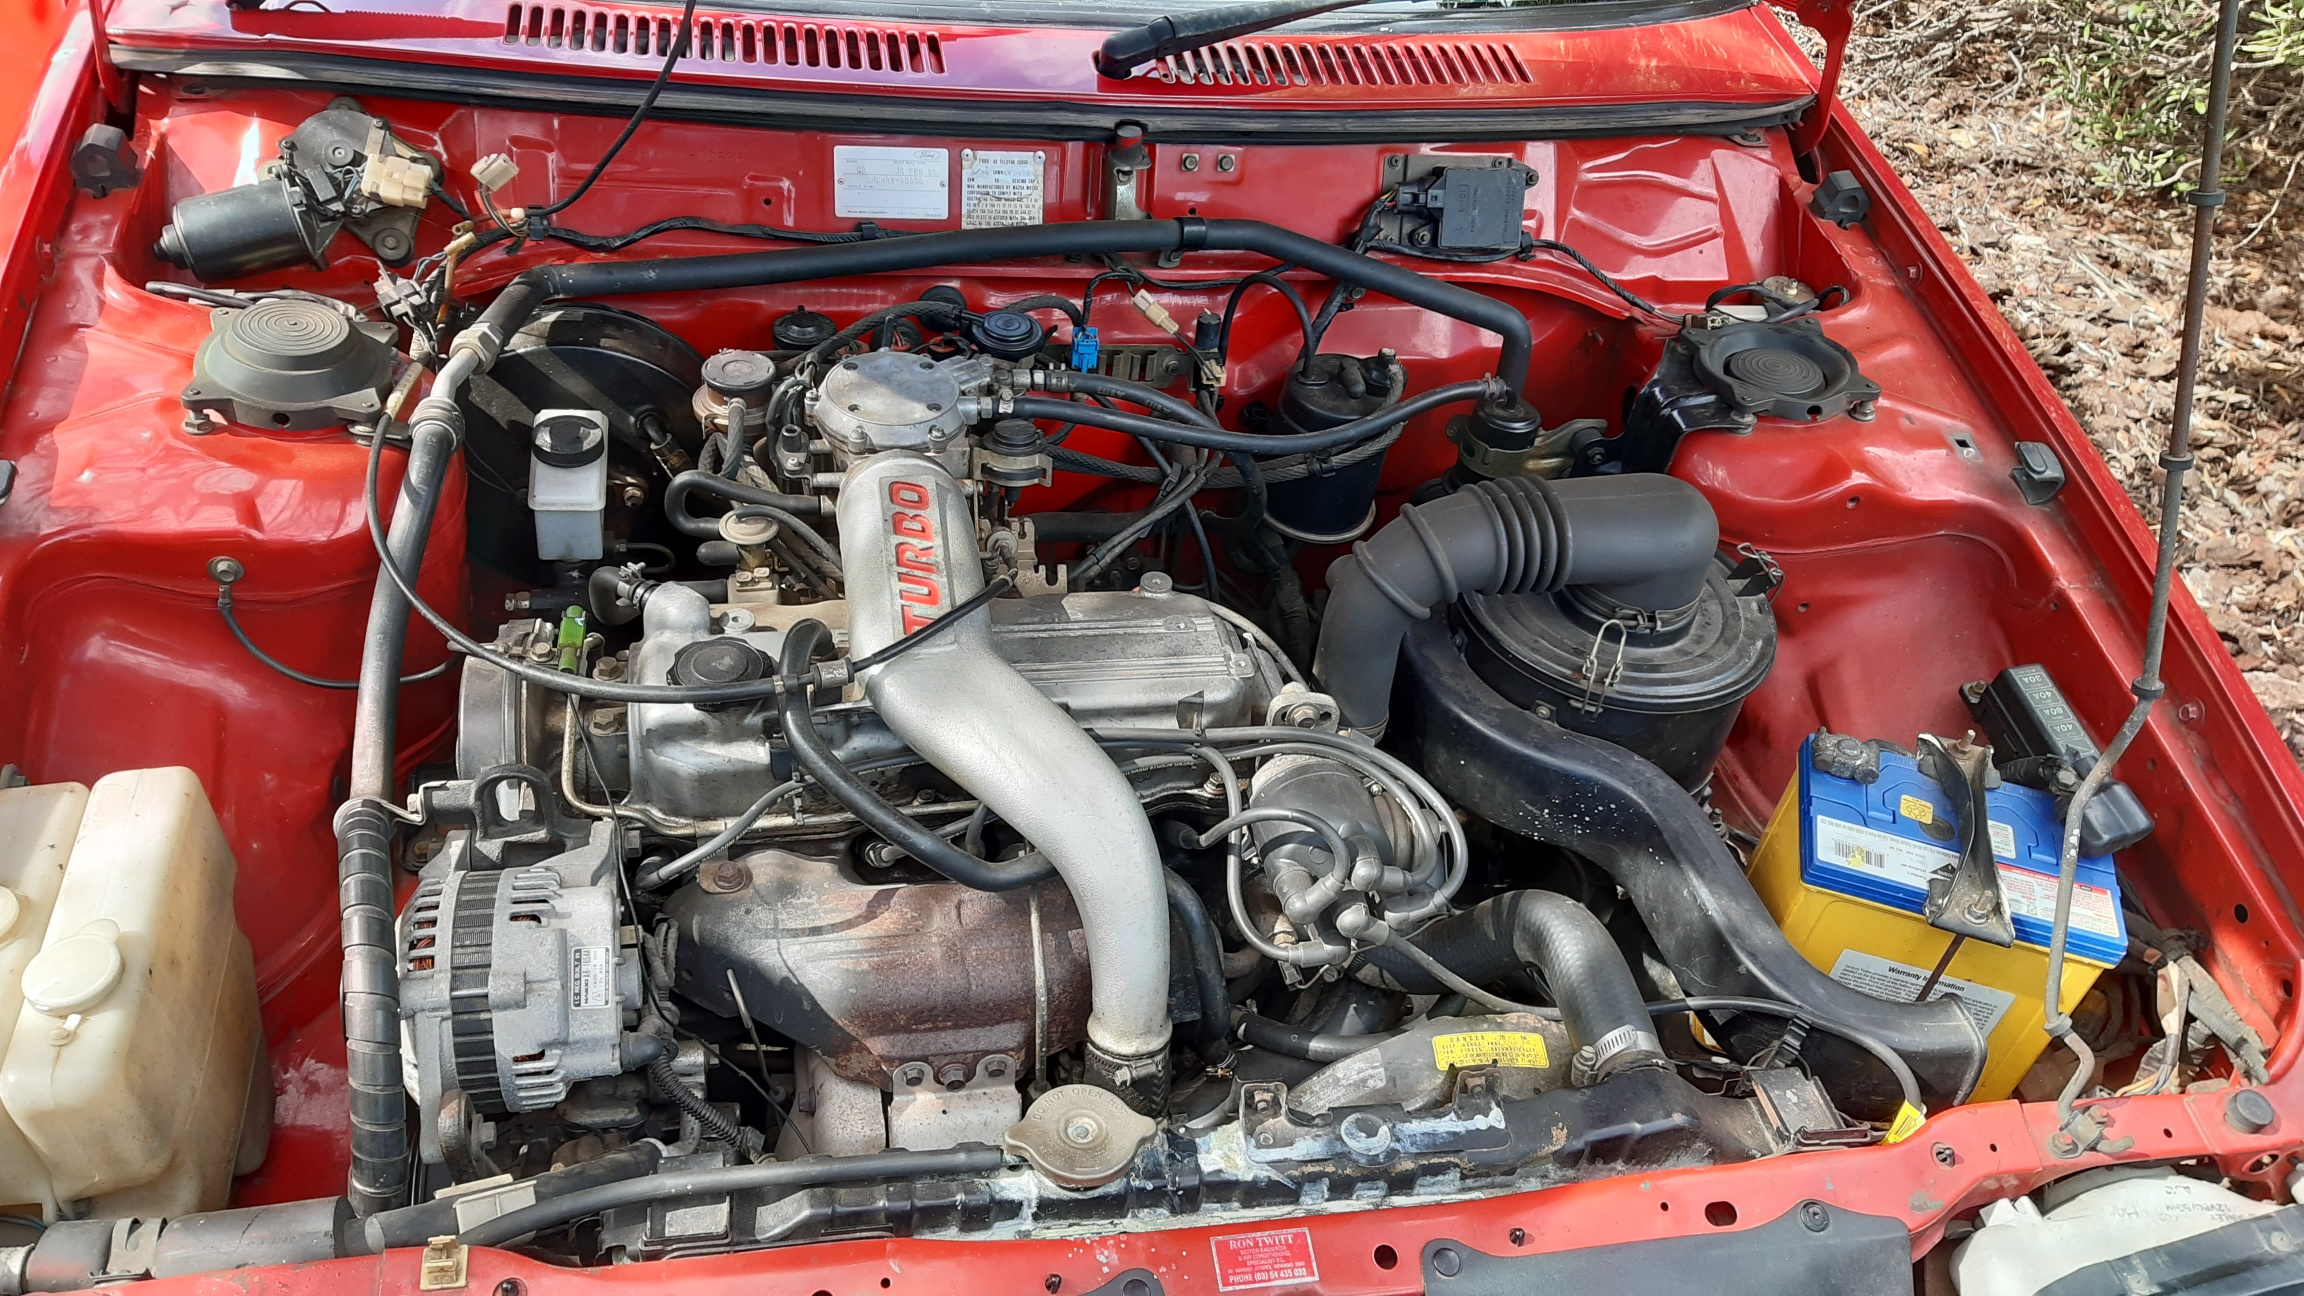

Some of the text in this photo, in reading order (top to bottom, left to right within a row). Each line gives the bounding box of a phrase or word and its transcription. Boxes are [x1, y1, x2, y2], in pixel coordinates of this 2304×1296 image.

[888, 480, 941, 636] TURBO
[2032, 690, 2052, 699] 40A
[2054, 724, 2073, 733] 40A
[1906, 870, 1925, 880] Century
[1857, 980, 1875, 988] product
[1886, 966, 1966, 991] Warranty Inrmation
[1030, 1107, 1046, 1121] DO
[1043, 1090, 1065, 1106] NOT
[1071, 1088, 1103, 1098] OPEN
[1108, 1097, 1129, 1115] HOT
[1229, 1234, 1294, 1250] RON TWITT
[1253, 1251, 1290, 1259] CONDITIONING
[1229, 1274, 1253, 1283] PHONE
[1254, 1272, 1268, 1281] (03)
[1279, 1269, 1292, 1277] 435
